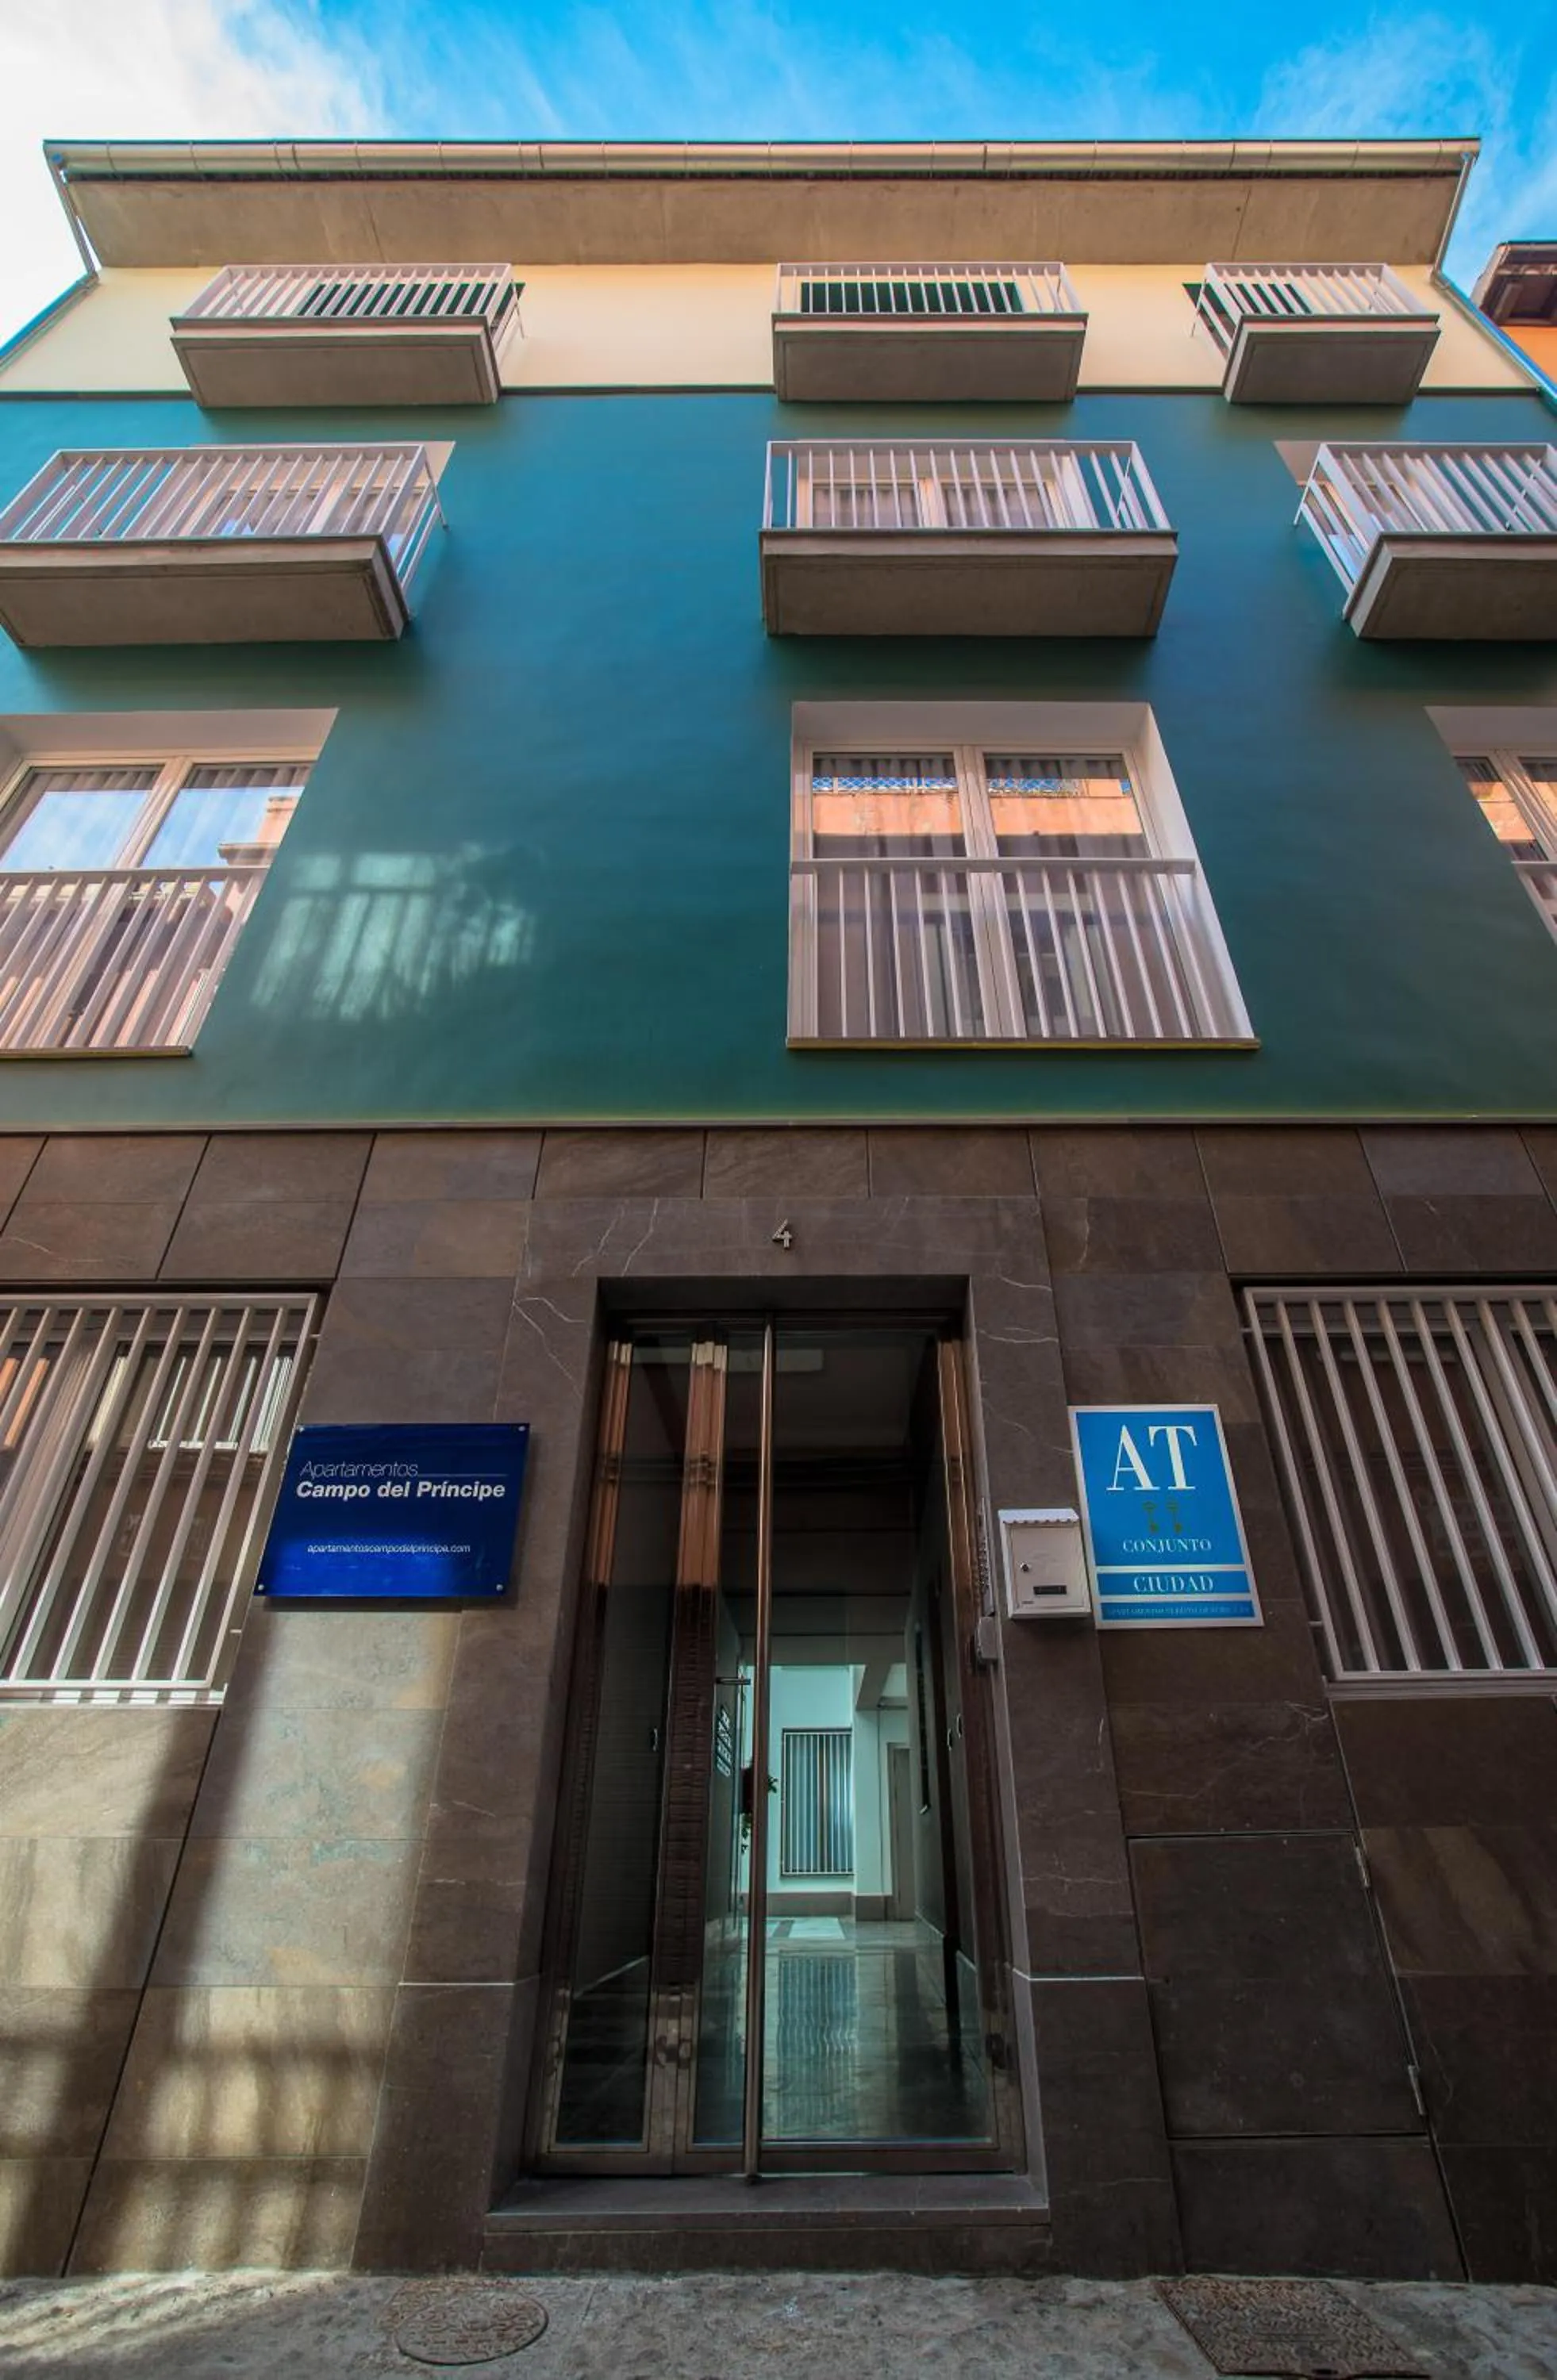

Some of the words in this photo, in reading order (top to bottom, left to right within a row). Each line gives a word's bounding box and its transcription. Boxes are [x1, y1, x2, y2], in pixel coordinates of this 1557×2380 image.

[772, 1219, 792, 1248] 4
[1106, 1425, 1198, 1491] AT
[299, 1461, 418, 1479] Apartamentos
[296, 1481, 371, 1501] Campo
[377, 1481, 411, 1498] del
[417, 1481, 506, 1501] Príncipe
[1123, 1538, 1212, 1553] CONJUNTO
[1134, 1576, 1213, 1592] CIUDAD
